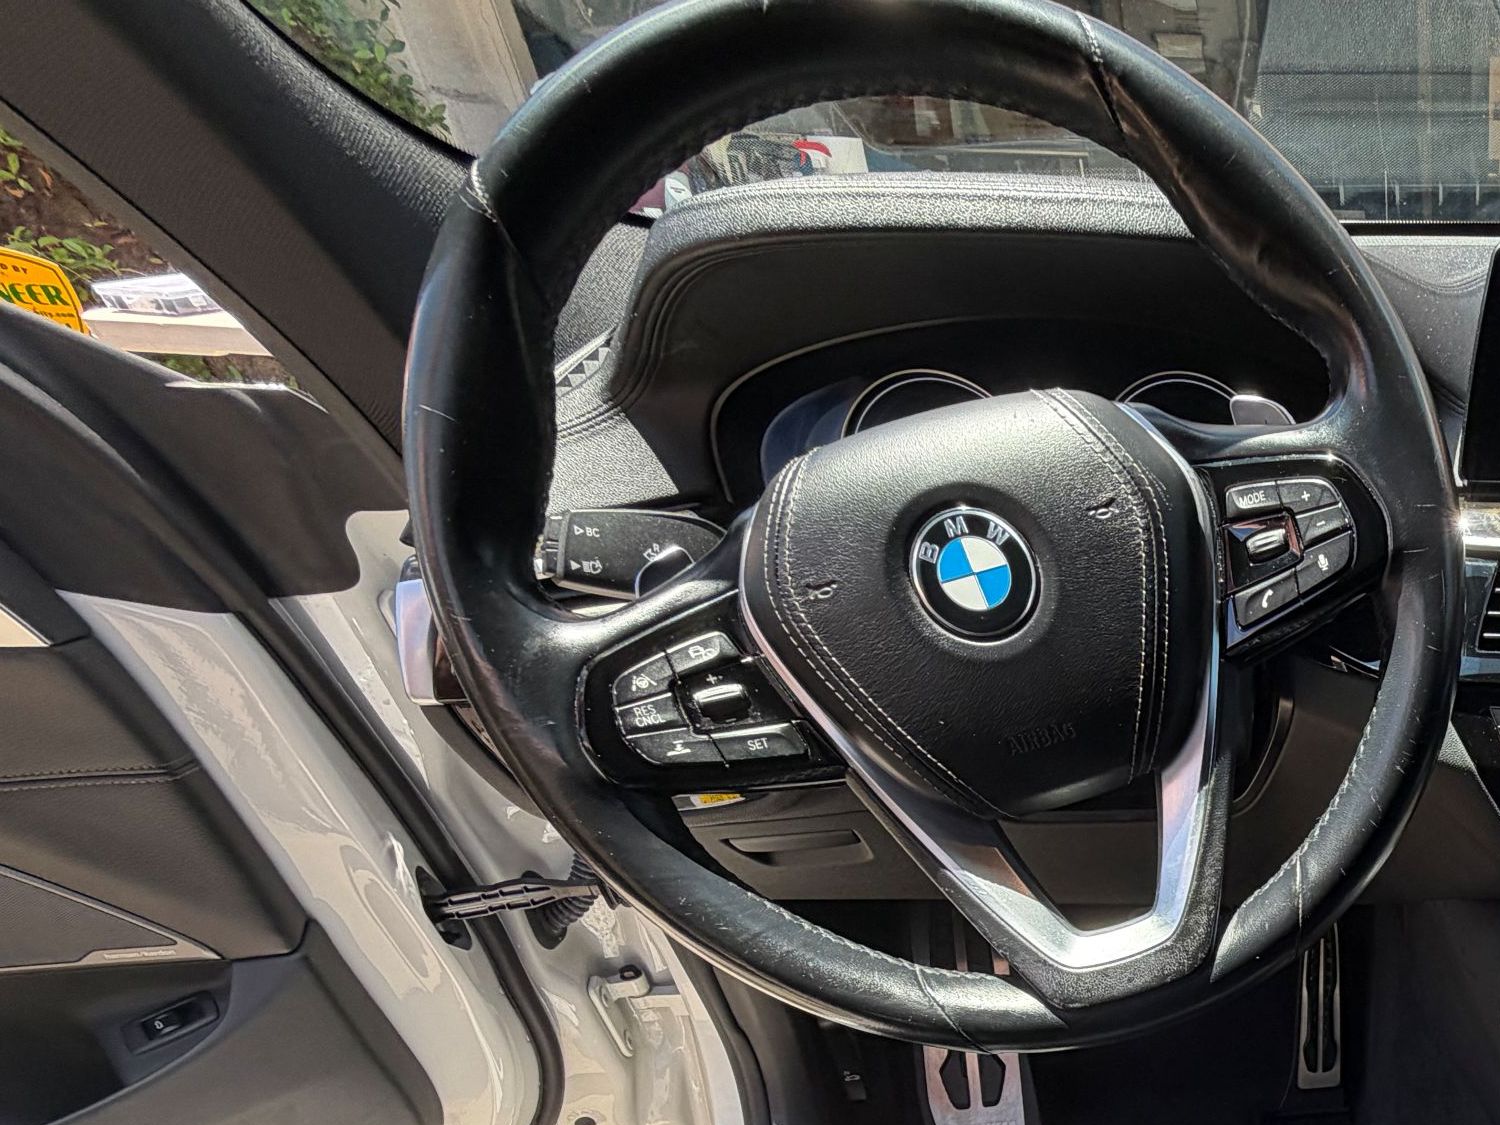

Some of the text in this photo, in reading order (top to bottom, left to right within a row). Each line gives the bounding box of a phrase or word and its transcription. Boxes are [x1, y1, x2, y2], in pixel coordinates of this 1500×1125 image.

[1238, 490, 1266, 506] MODE
[585, 527, 600, 538] BC
[918, 515, 1010, 564] BMW
[633, 704, 656, 718] RES
[635, 713, 666, 728] CNCL
[747, 737, 769, 751] SET
